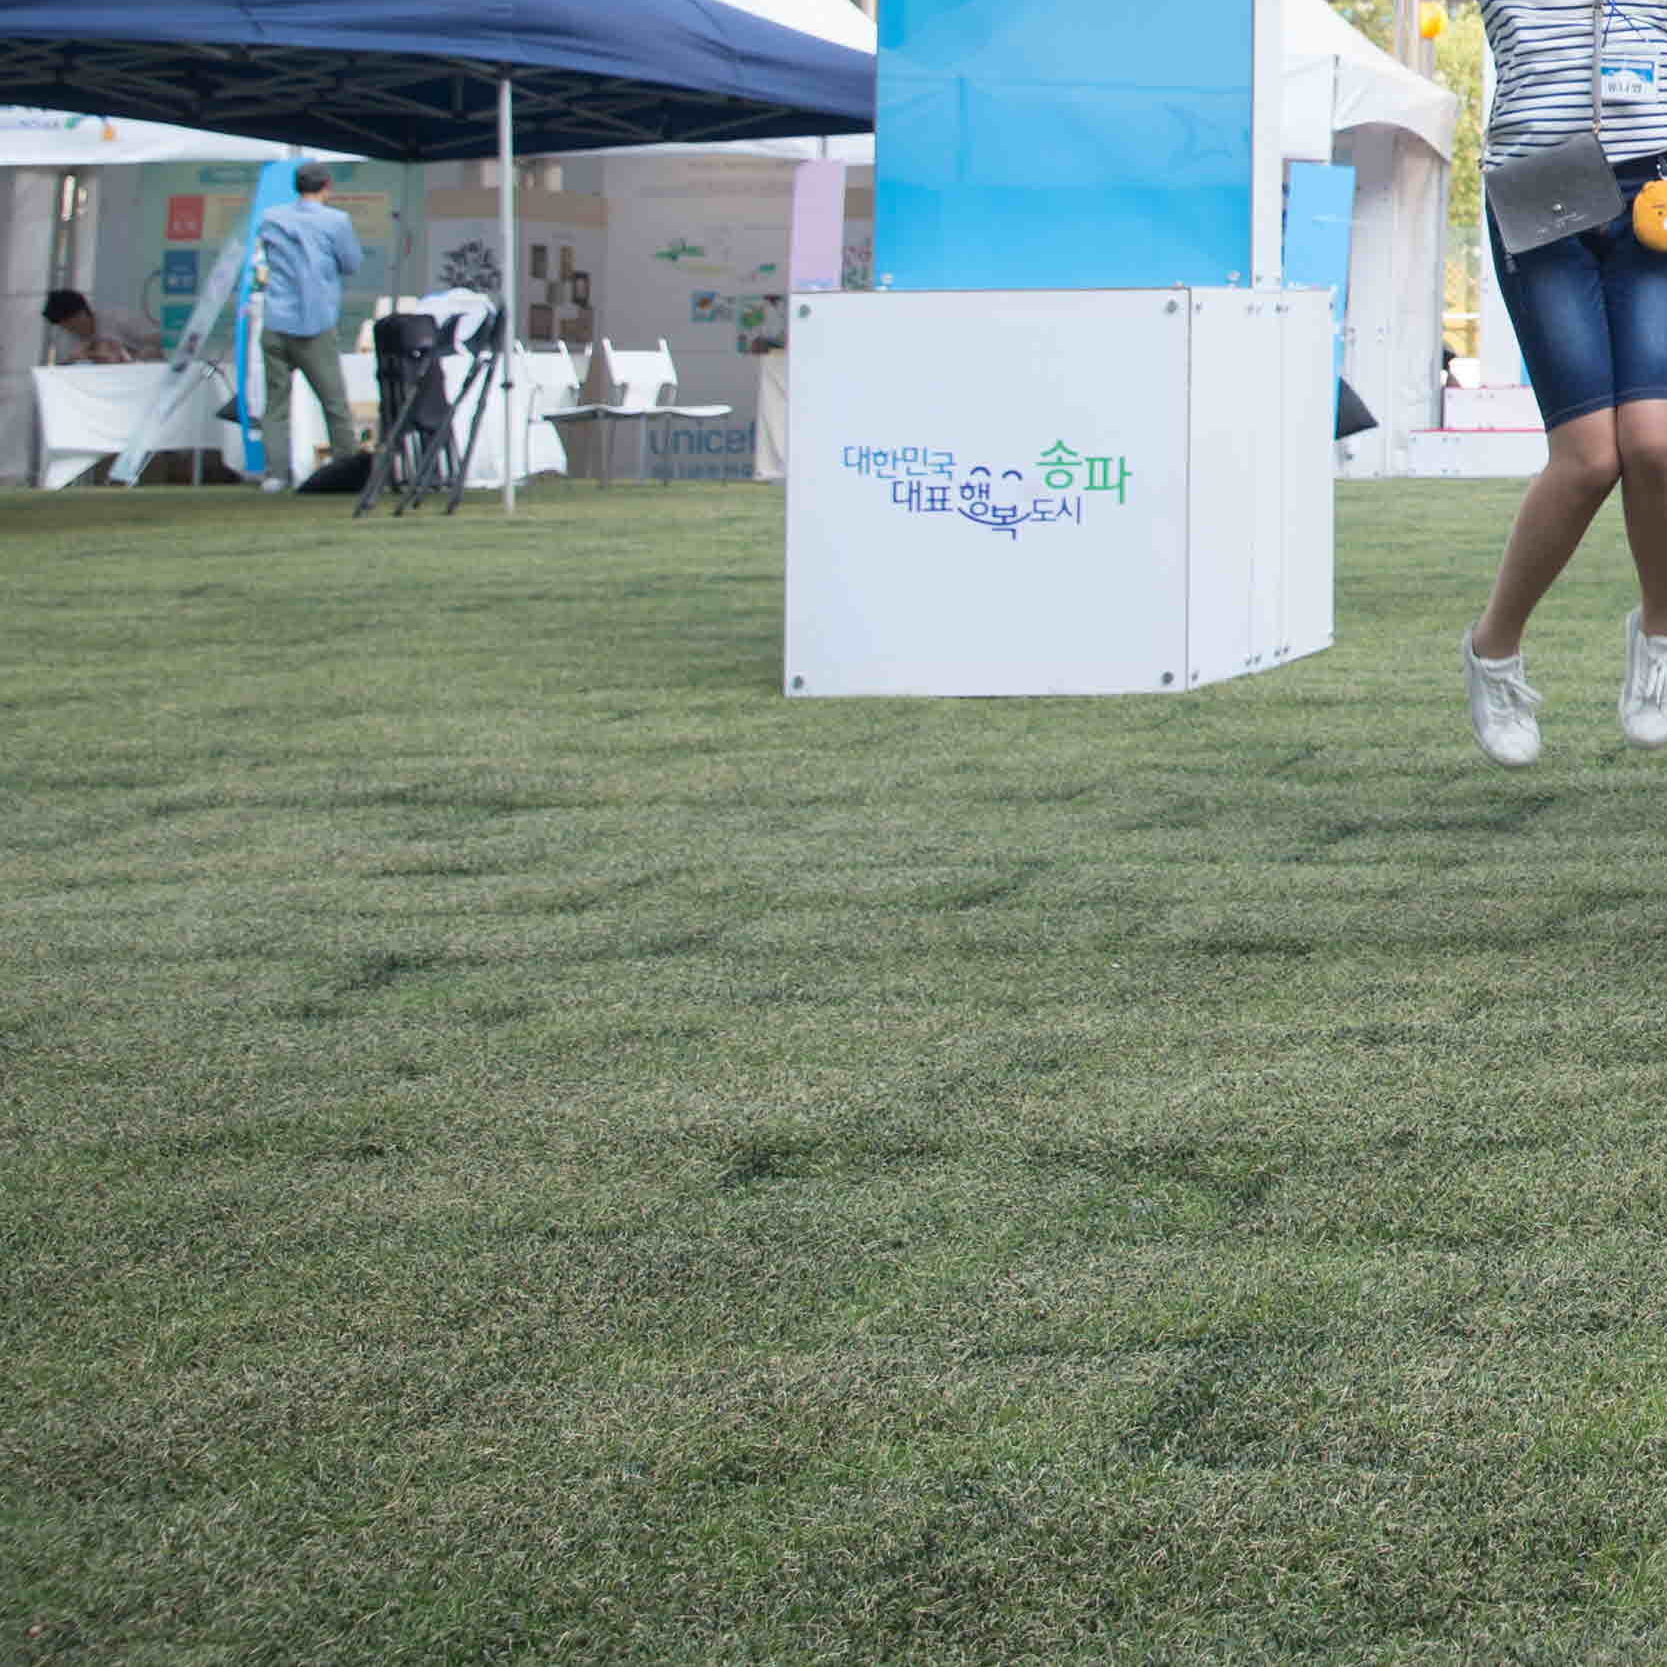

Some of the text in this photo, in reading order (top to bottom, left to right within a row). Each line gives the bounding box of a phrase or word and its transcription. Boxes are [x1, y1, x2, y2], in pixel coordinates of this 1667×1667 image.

[841, 445, 957, 481] 대한민국
[1035, 438, 1133, 505] 송파
[891, 479, 953, 513] 대표
